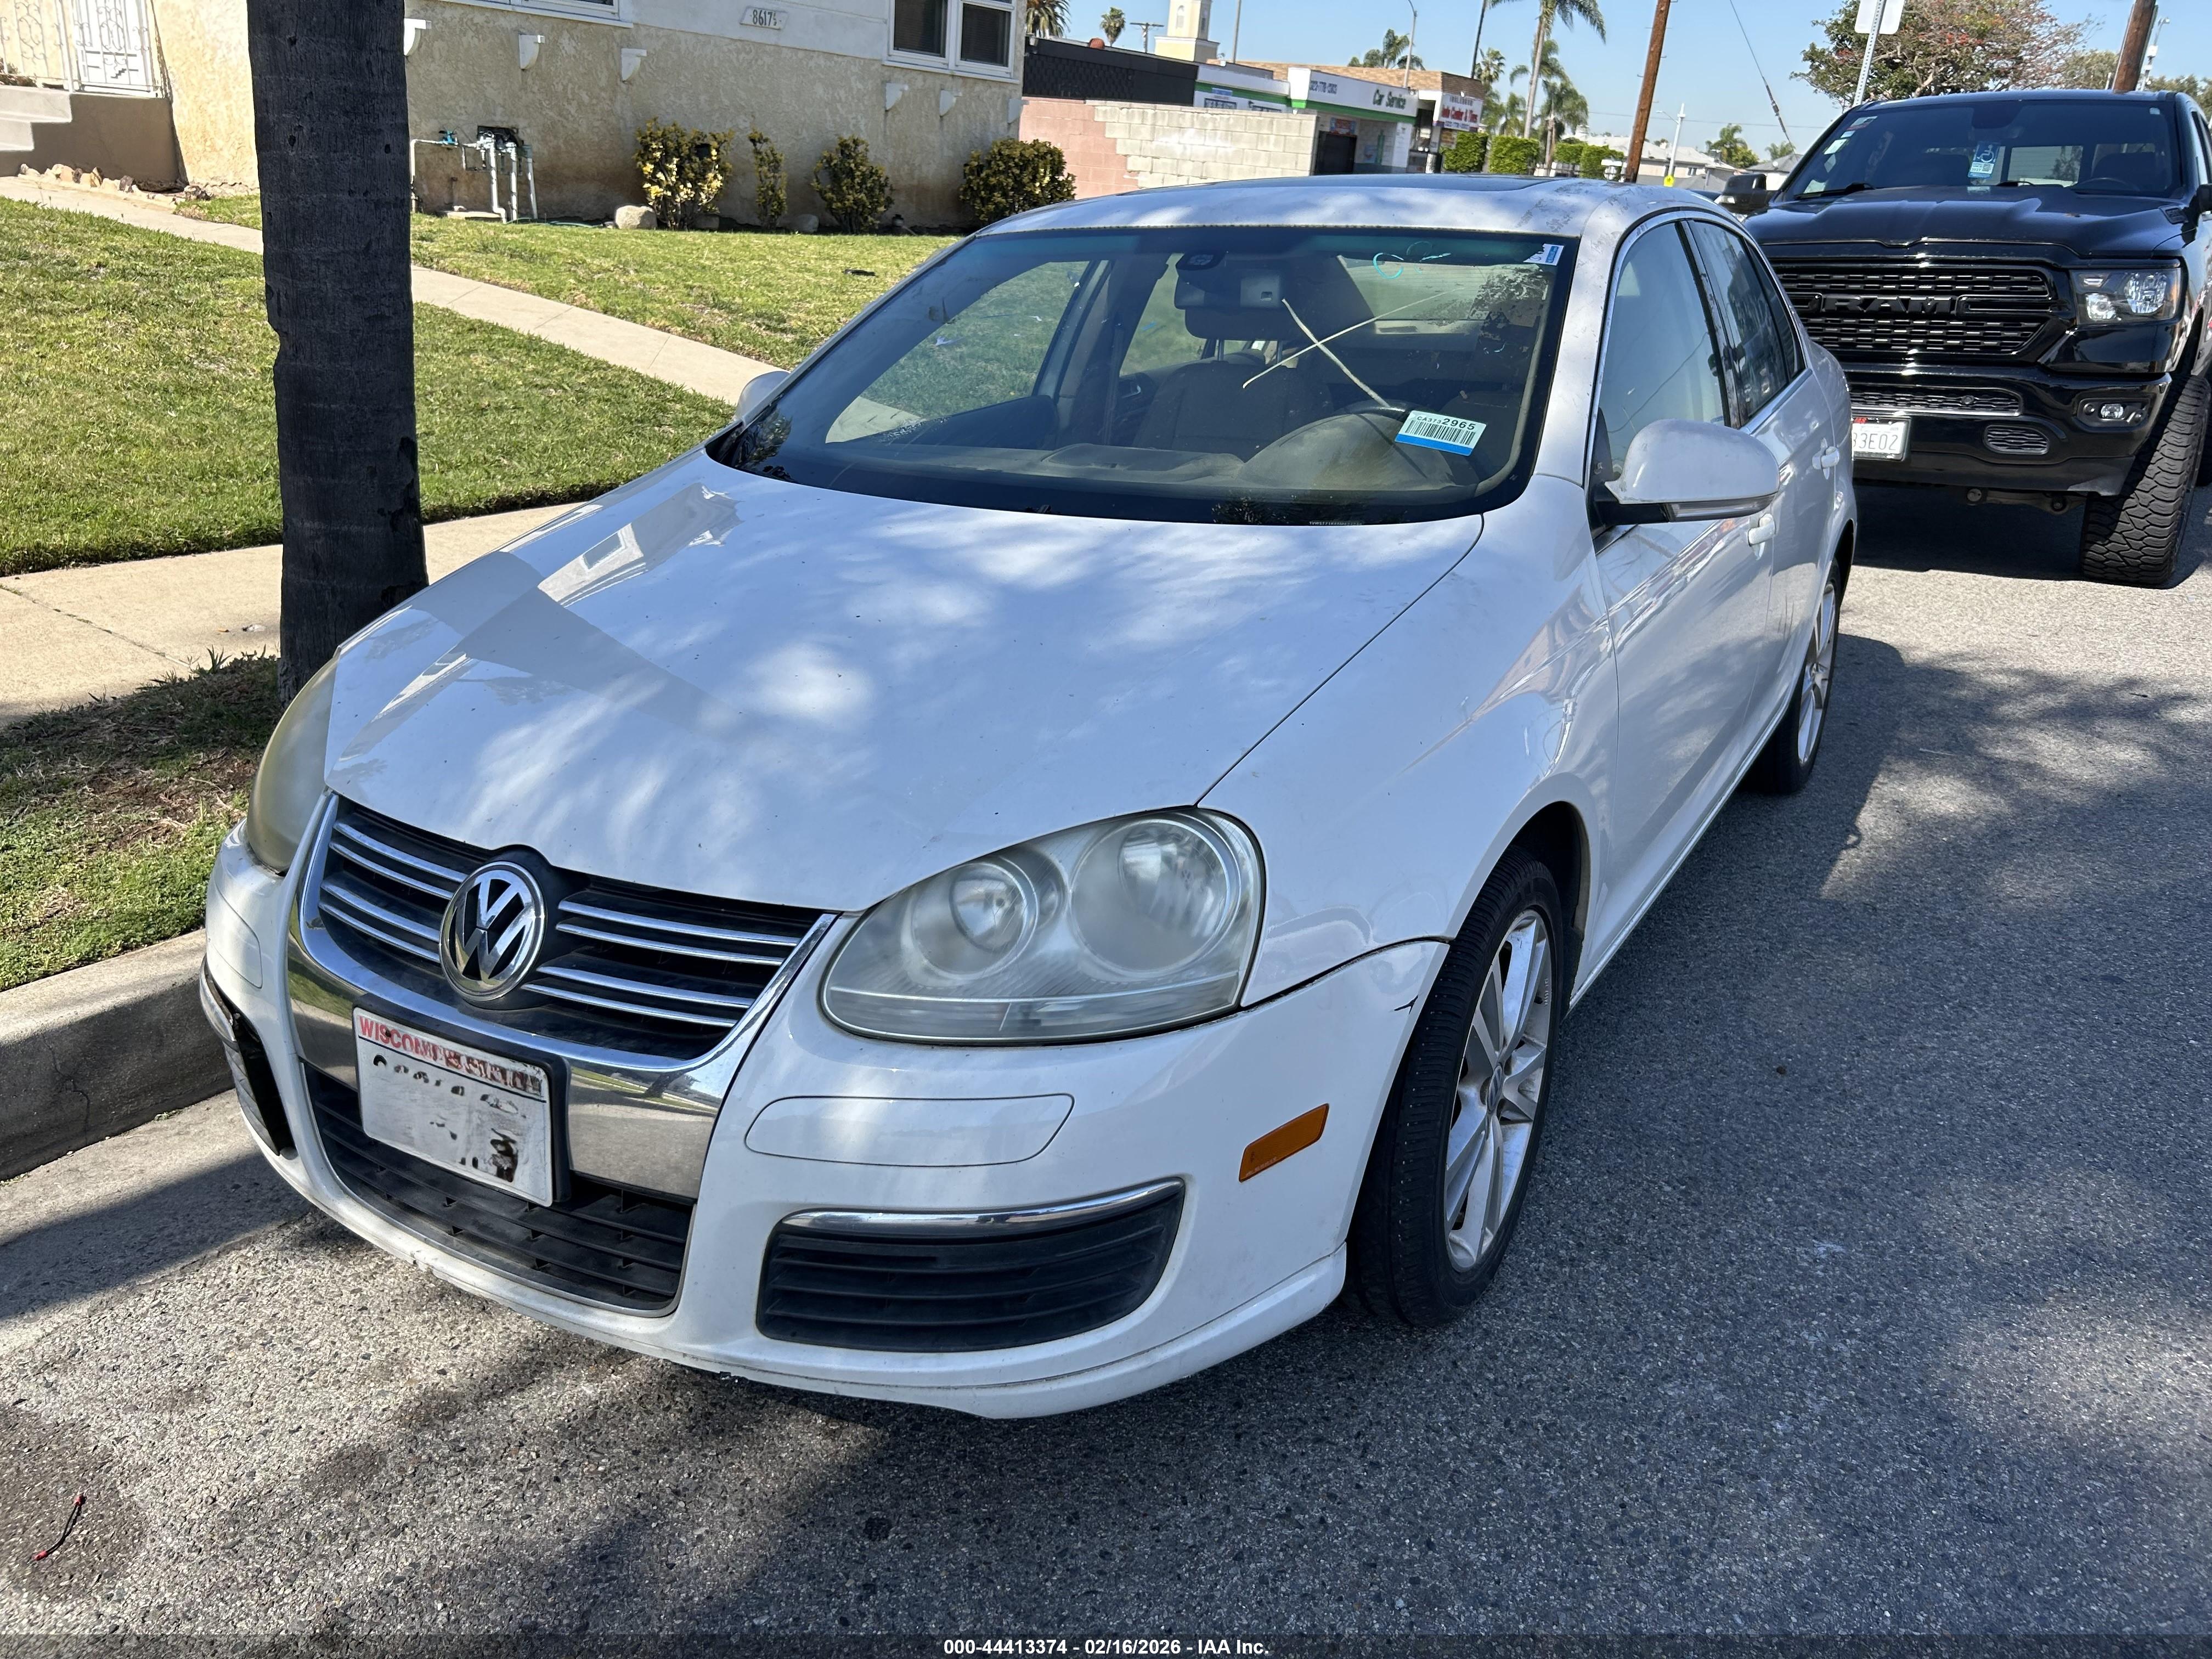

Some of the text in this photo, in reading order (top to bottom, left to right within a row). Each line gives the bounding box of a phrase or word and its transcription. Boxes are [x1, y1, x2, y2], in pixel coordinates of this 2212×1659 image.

[1373, 89, 1406, 109] Car Service
[1823, 295, 1952, 313] RAM
